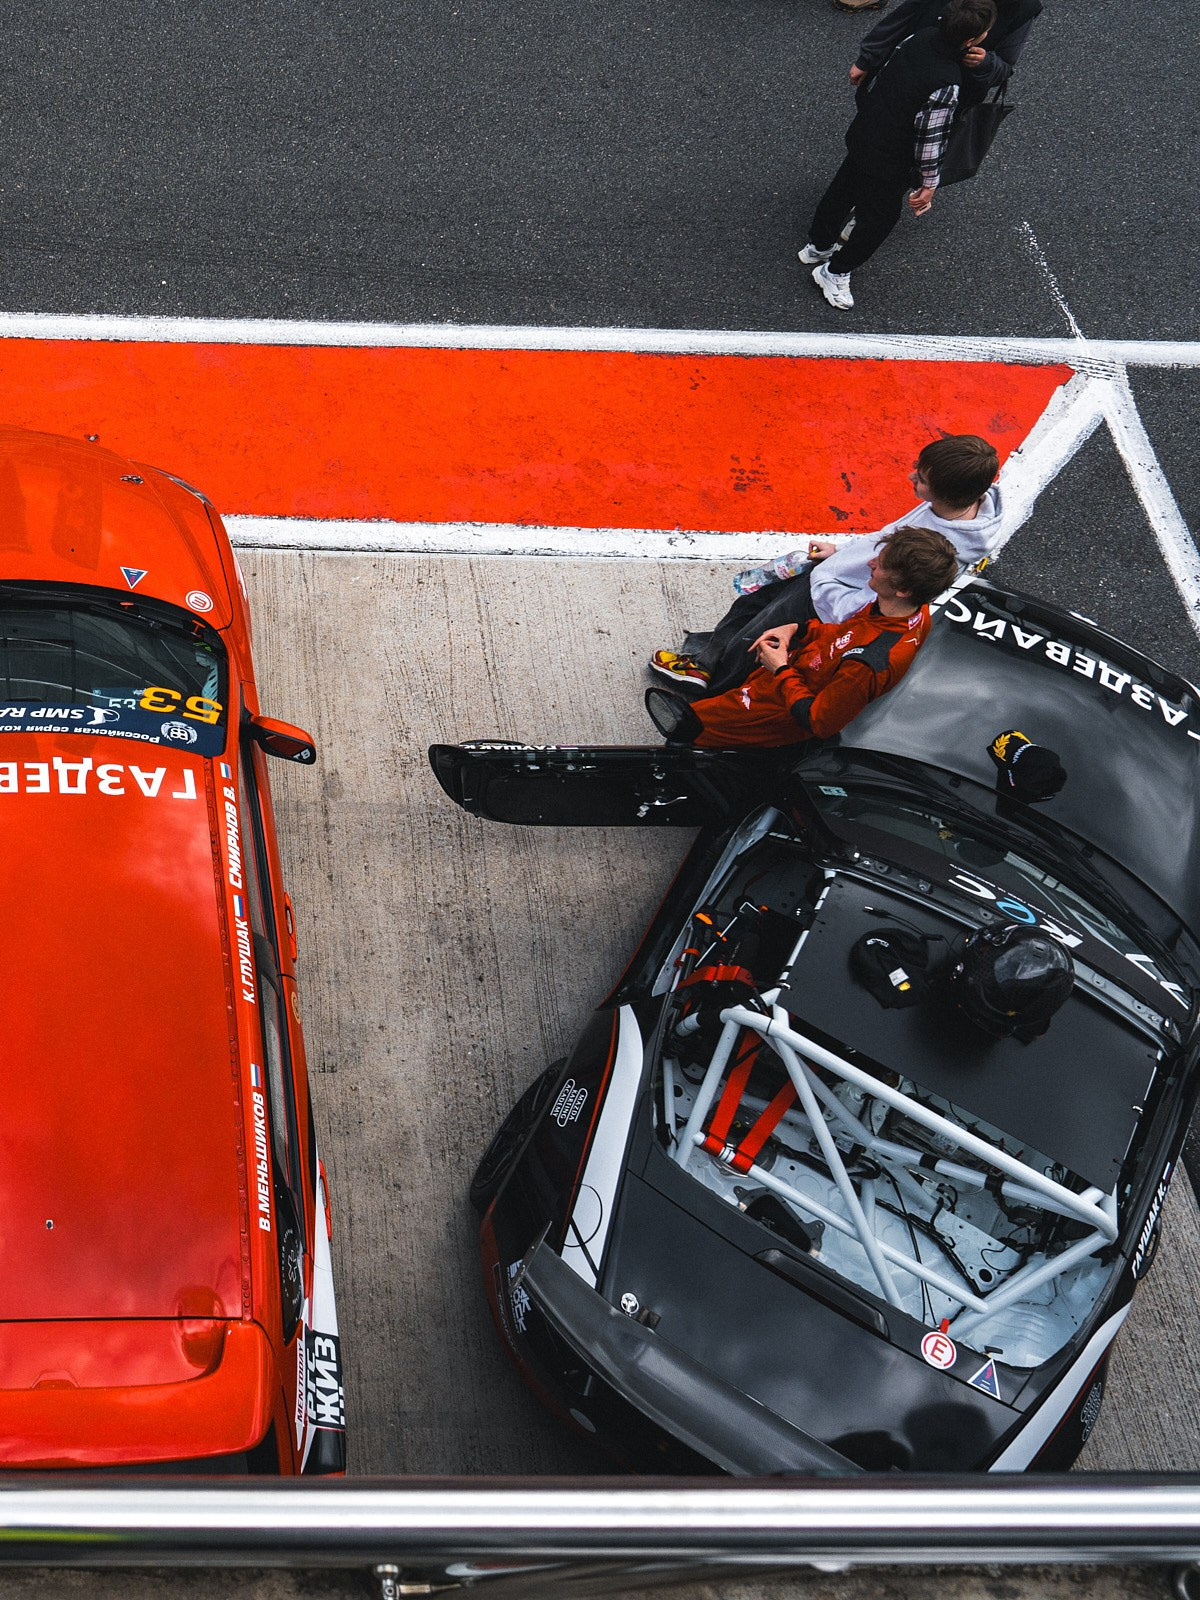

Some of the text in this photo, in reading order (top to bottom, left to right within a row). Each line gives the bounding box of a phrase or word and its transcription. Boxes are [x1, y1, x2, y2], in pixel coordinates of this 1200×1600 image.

[26, 724, 69, 733] серия
[30, 708, 85, 720] SMP
[74, 726, 160, 744] Российская
[139, 686, 224, 725] 53
[223, 786, 243, 890] СМИРНОВ В.
[235, 917, 256, 1004] К.ГЛУШАК
[252, 1091, 271, 1232] В.МЕНЬШИКОВ
[297, 1342, 306, 1423] MEN TODAY
[307, 1347, 317, 1421] РГС
[314, 1336, 340, 1425] ЖИЗ
[930, 1338, 948, 1362] E
